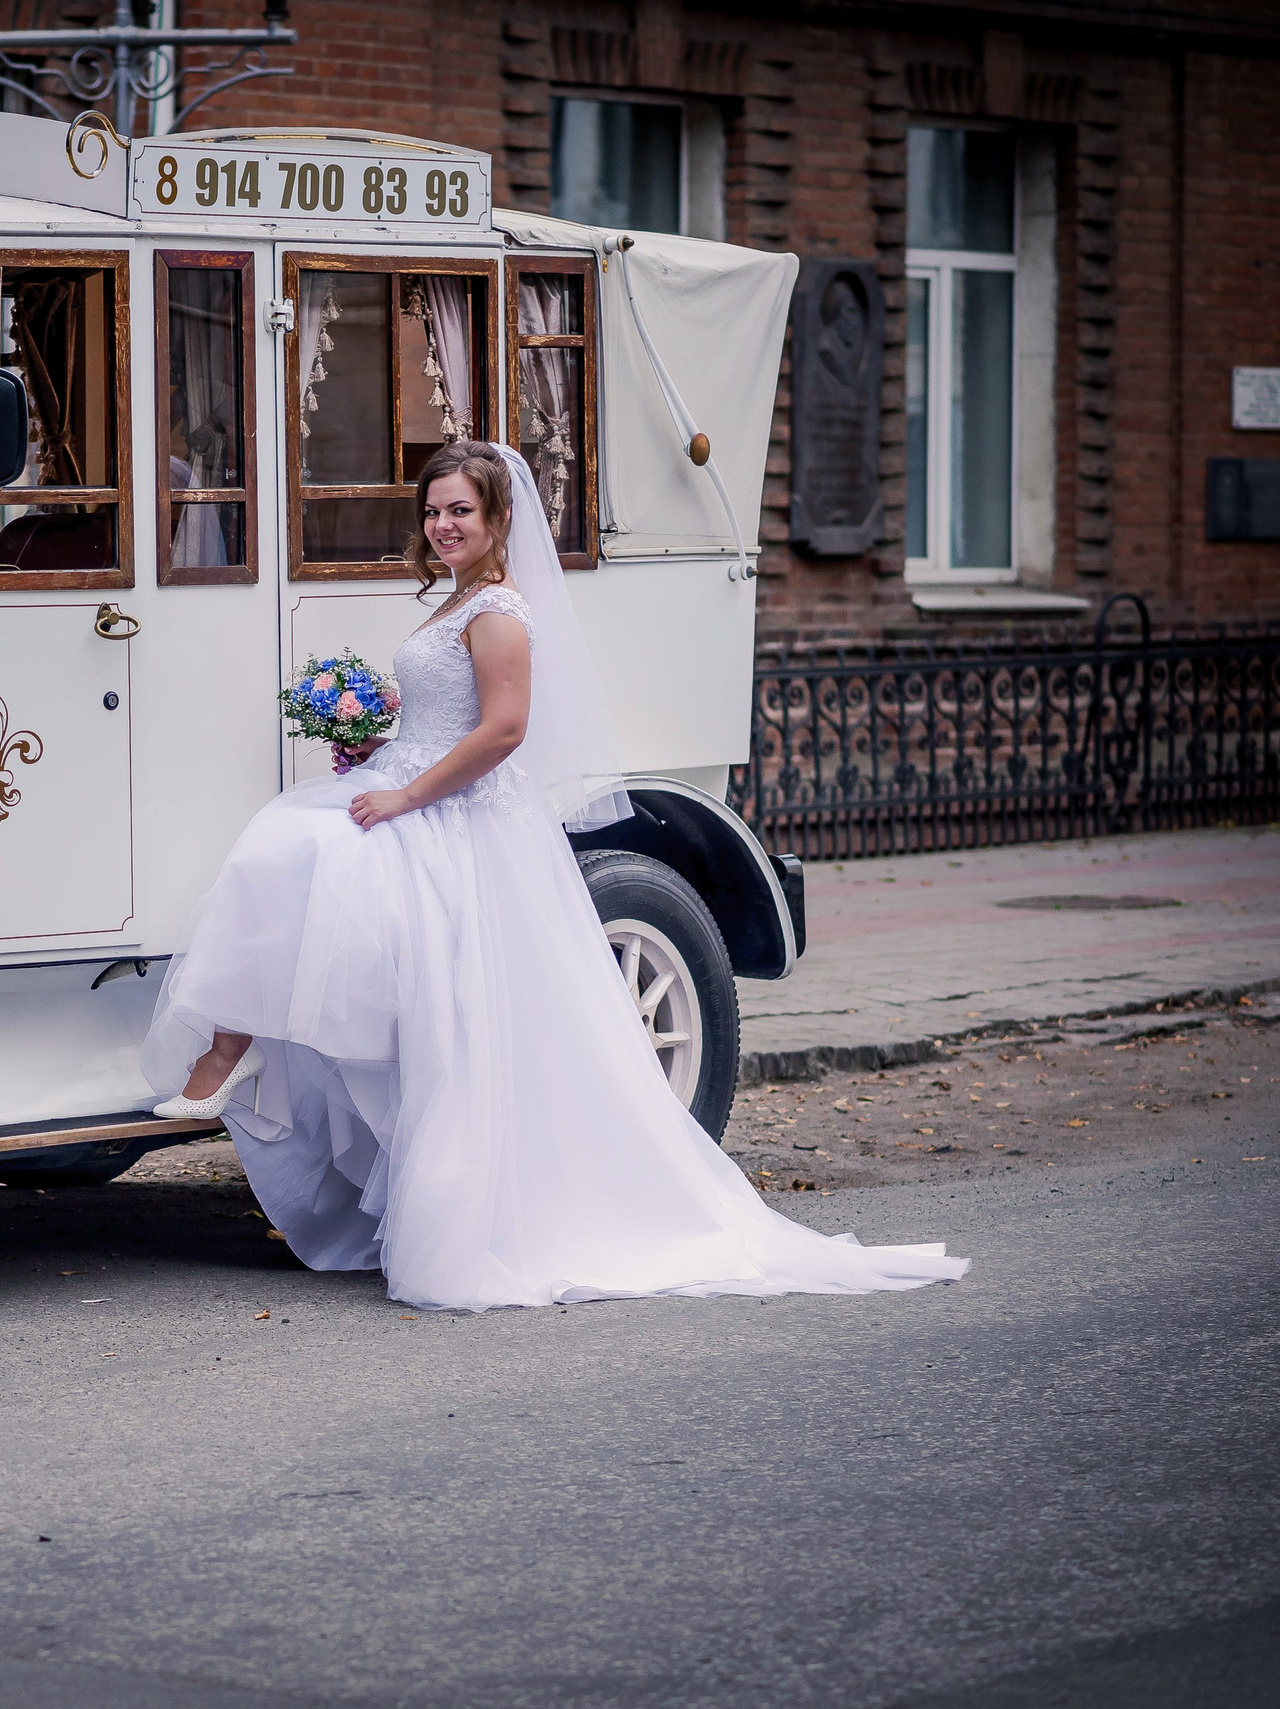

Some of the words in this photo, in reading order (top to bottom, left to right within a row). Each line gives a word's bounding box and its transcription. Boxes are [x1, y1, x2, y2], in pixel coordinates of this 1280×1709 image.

[156, 155, 179, 206] 8
[195, 157, 261, 208] 914
[278, 162, 345, 212] 700
[362, 166, 408, 215] 83
[425, 169, 469, 218] 93
